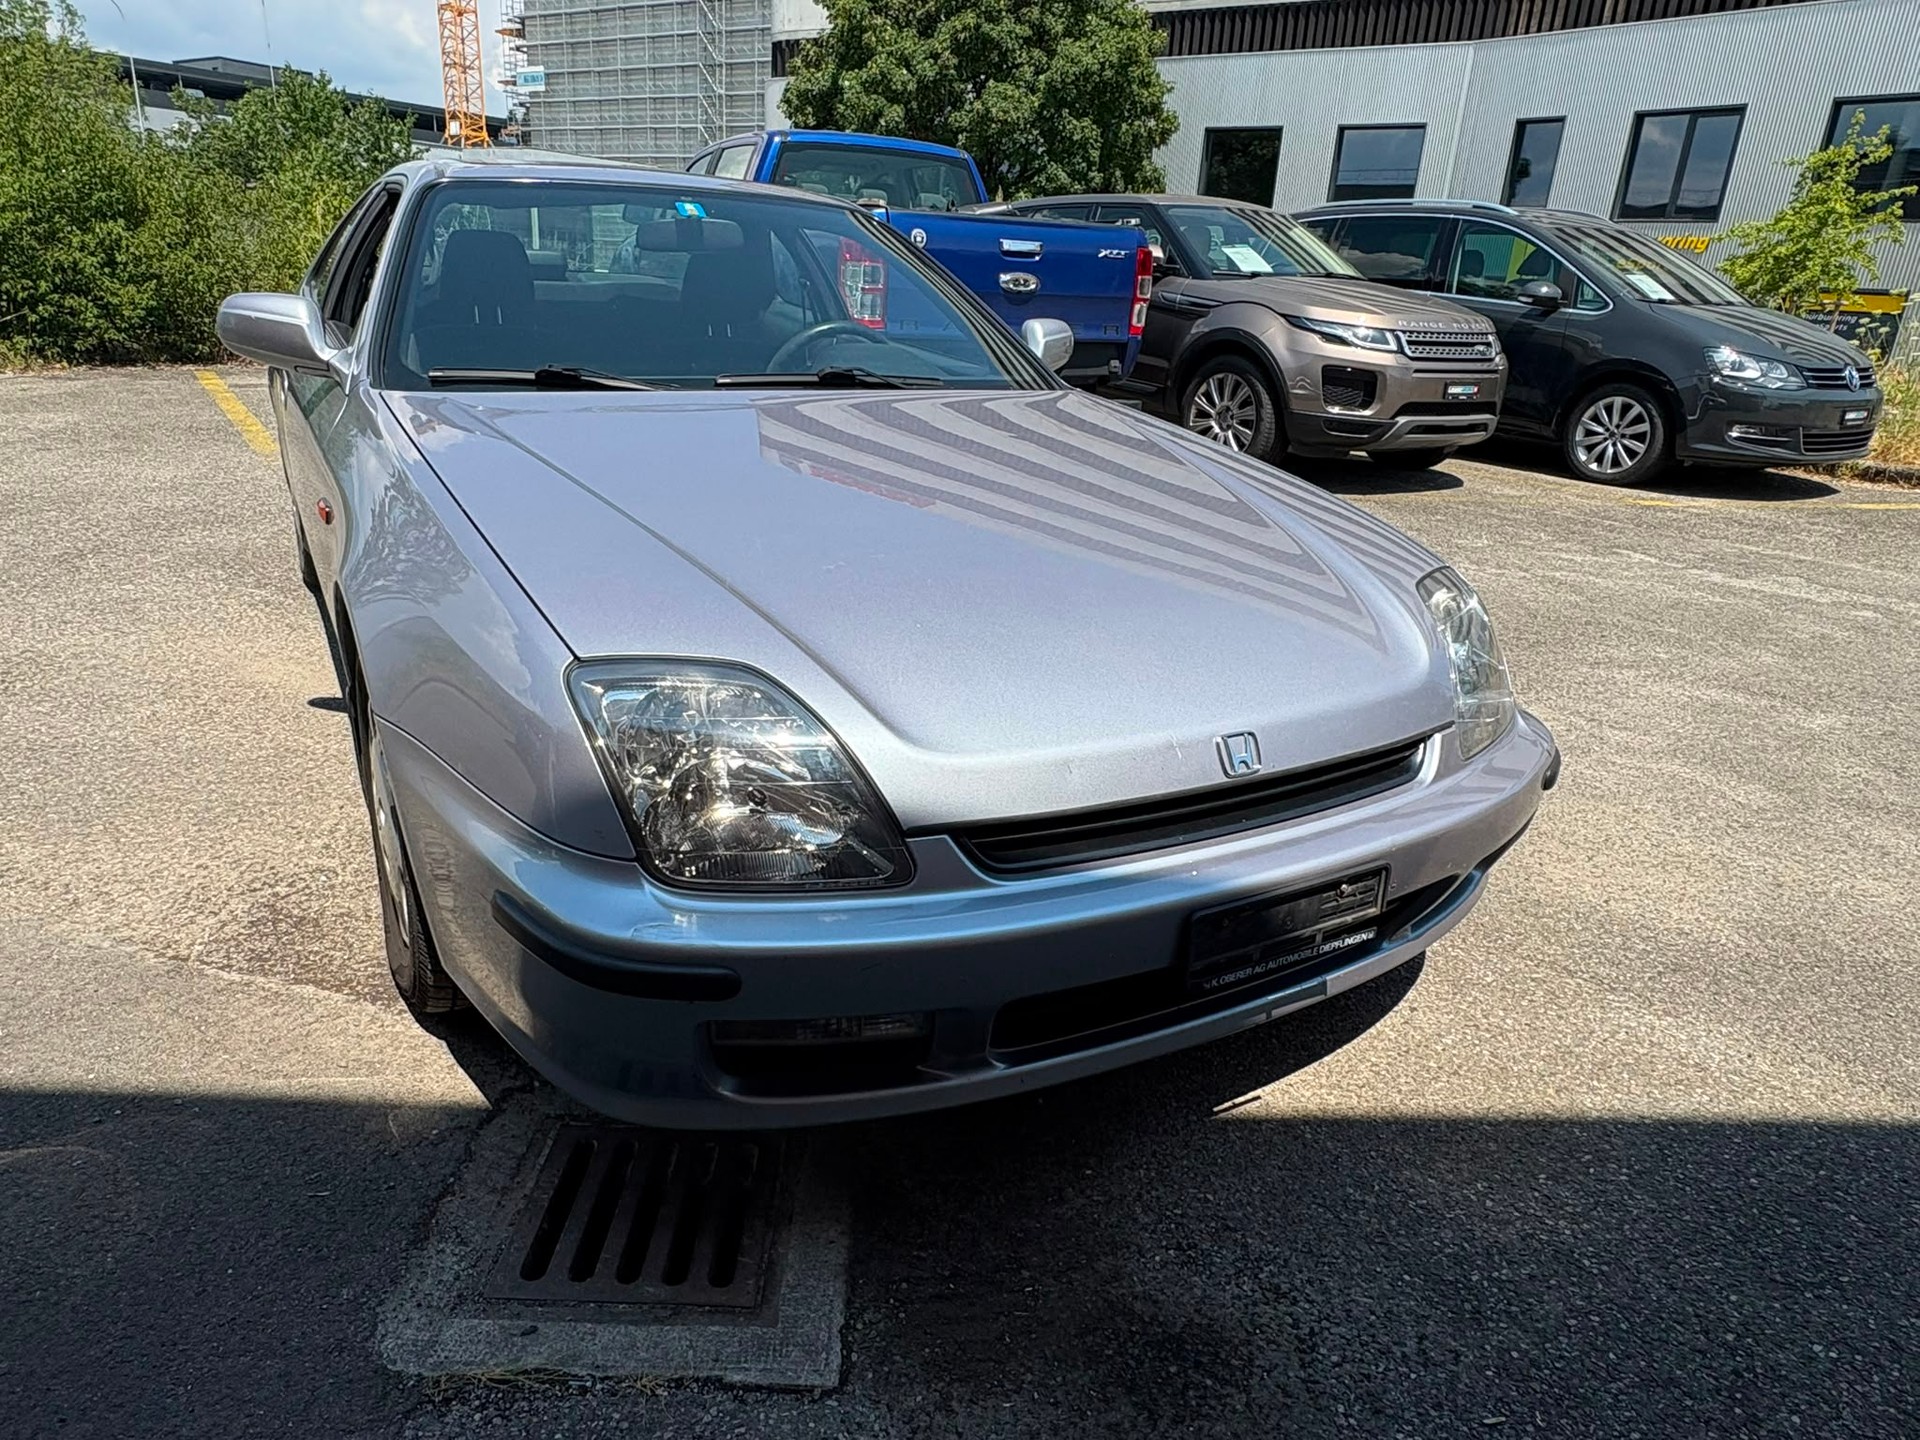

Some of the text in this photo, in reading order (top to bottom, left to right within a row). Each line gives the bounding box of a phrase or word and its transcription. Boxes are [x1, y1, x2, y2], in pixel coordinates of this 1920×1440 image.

[1398, 320, 1447, 329] RANGE
[1220, 967, 1252, 985] OBERER
[1253, 963, 1267, 975] AG
[1266, 947, 1319, 971] AUTOMOBILE
[1319, 931, 1368, 954] DIEPFLINGEN
